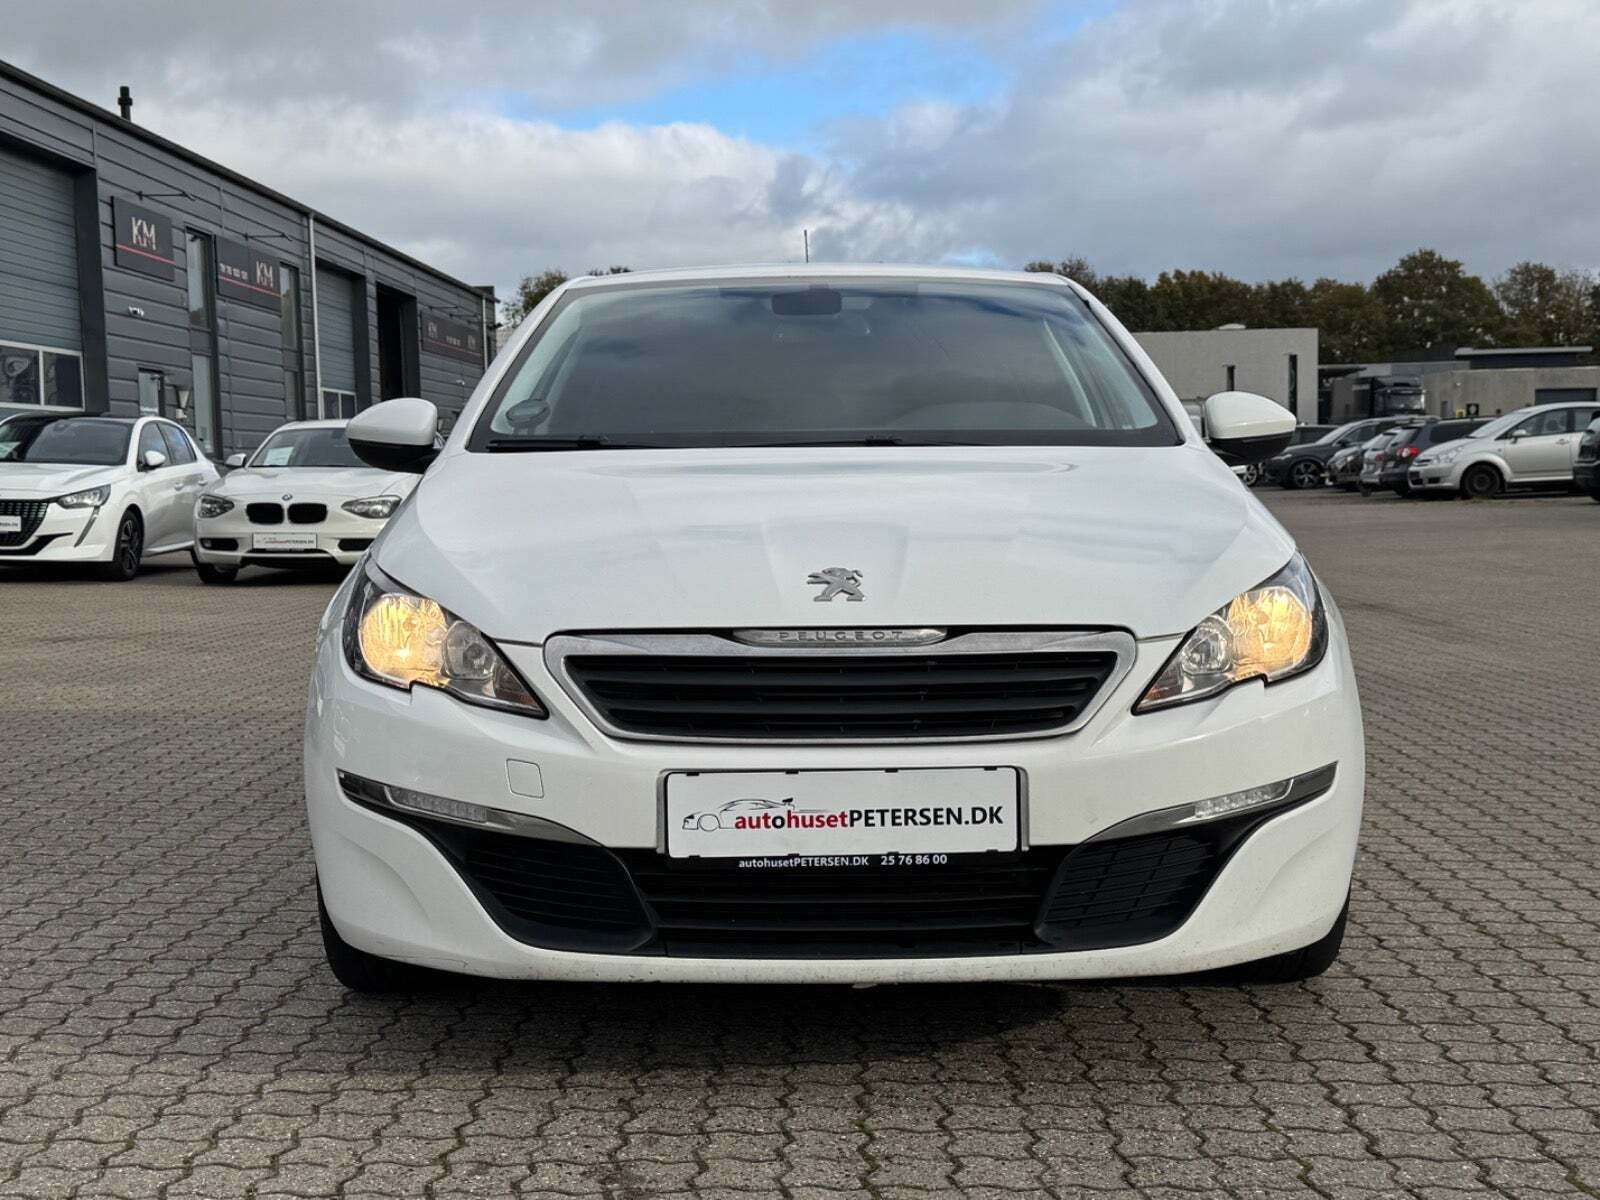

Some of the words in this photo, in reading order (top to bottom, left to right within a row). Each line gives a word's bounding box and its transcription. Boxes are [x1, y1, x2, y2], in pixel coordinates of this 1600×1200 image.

[131, 216, 157, 251] KM
[256, 260, 273, 288] KM
[778, 631, 904, 641] PEUGEOT
[735, 806, 1004, 830] autohusetPETERSEN.DK
[739, 856, 869, 868] autohusetPETERSEN.DK
[880, 856, 896, 867] 25
[898, 855, 914, 866] 76
[915, 855, 931, 866] 86
[932, 854, 948, 865] 00
